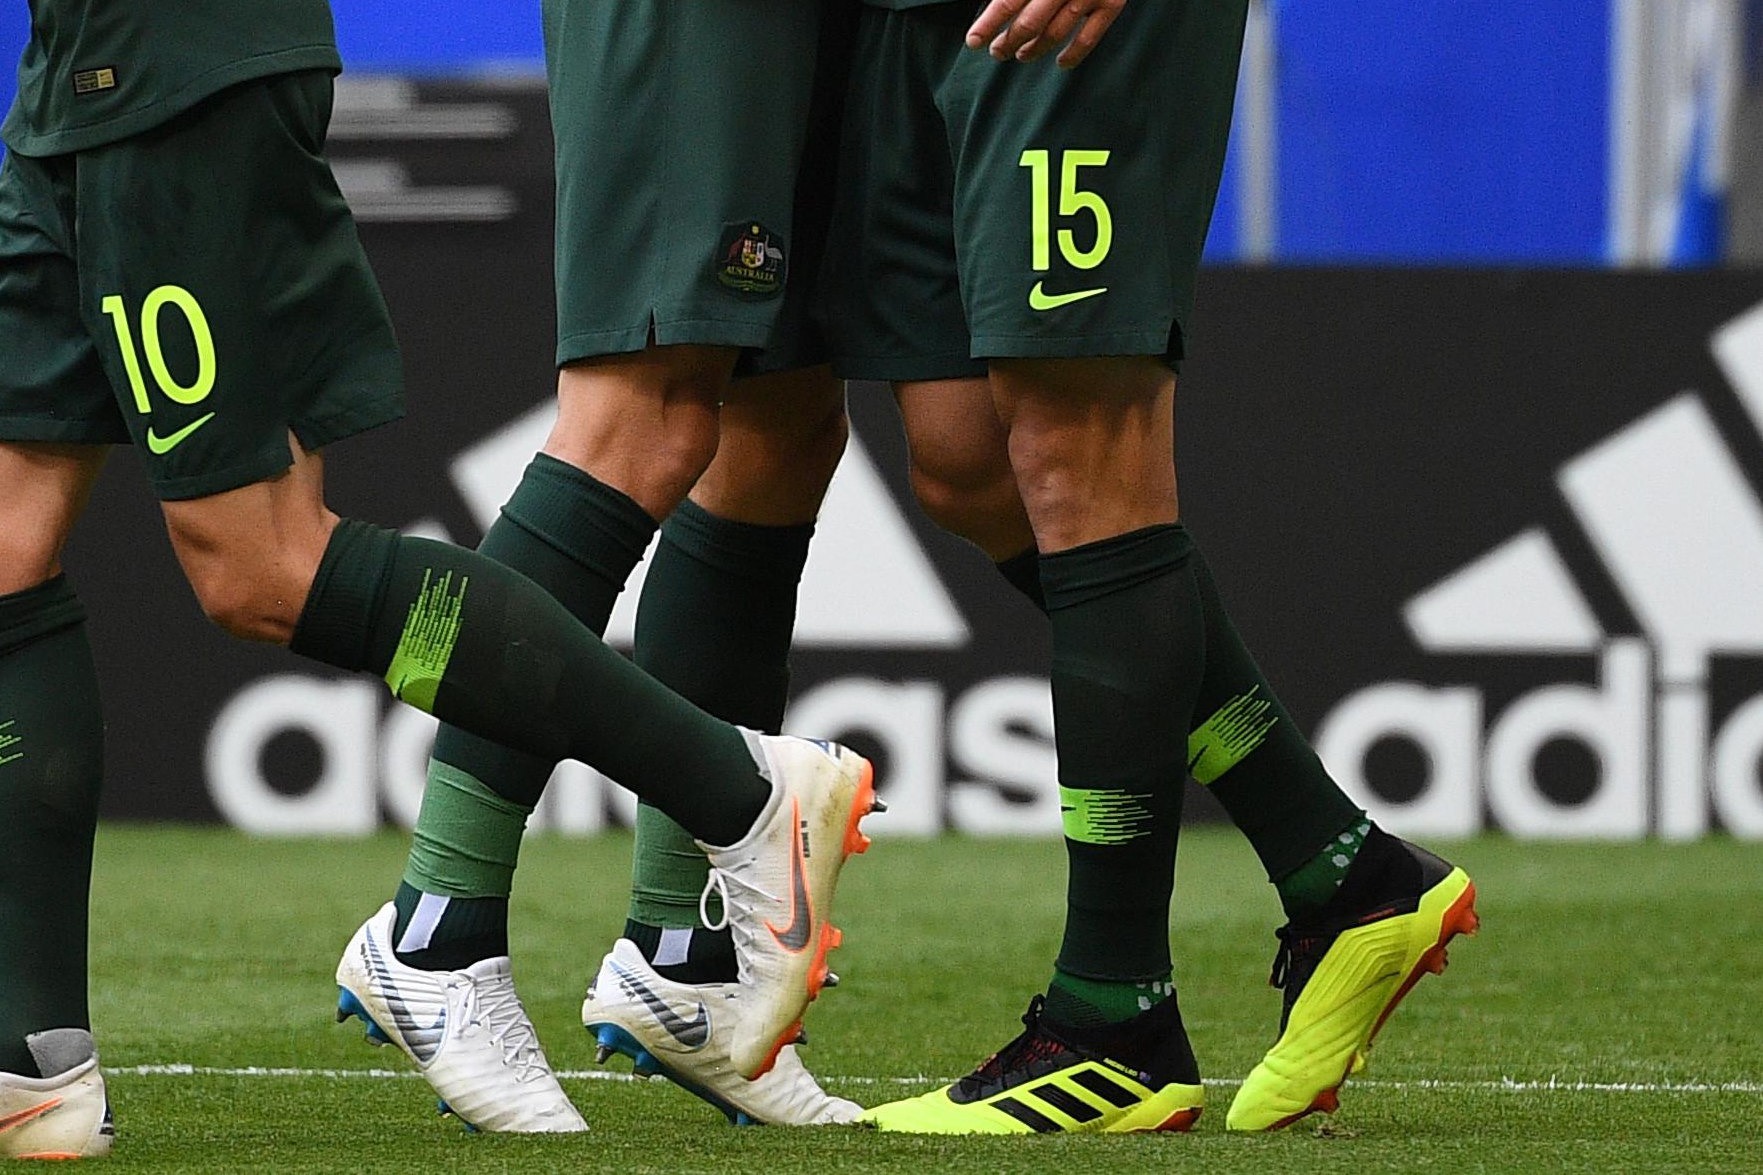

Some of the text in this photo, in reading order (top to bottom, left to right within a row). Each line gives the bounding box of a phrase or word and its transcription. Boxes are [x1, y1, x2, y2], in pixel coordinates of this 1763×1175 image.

[1019, 149, 1113, 271] 15
[102, 285, 216, 414] 10
[1311, 633, 1763, 841] adi
